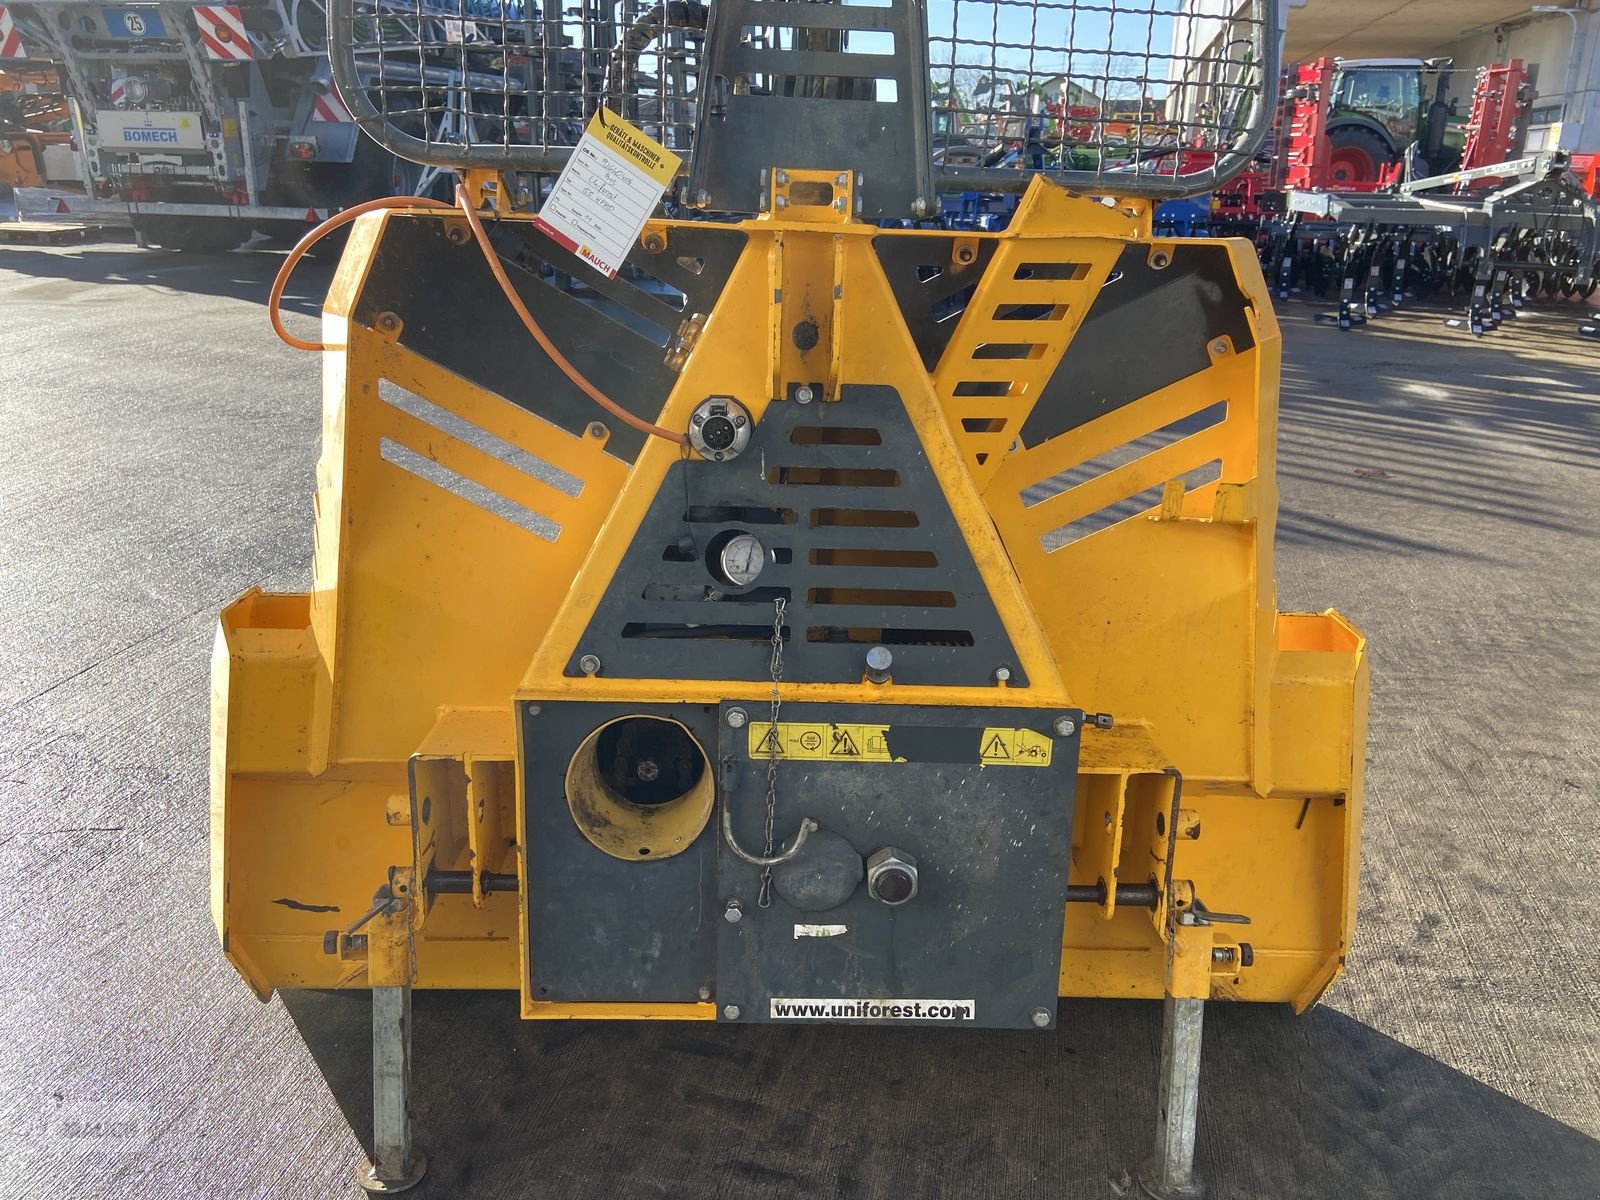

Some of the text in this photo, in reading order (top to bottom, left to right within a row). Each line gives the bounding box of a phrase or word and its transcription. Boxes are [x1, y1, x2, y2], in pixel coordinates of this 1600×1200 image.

[127, 15, 143, 32] 25
[123, 130, 178, 143] BOMECH
[609, 124, 627, 140] GERÄTE
[631, 139, 660, 162] MASCHINEN
[607, 131, 656, 169] QUALITÄTSKONTROLLE
[581, 248, 610, 272] MAUCH
